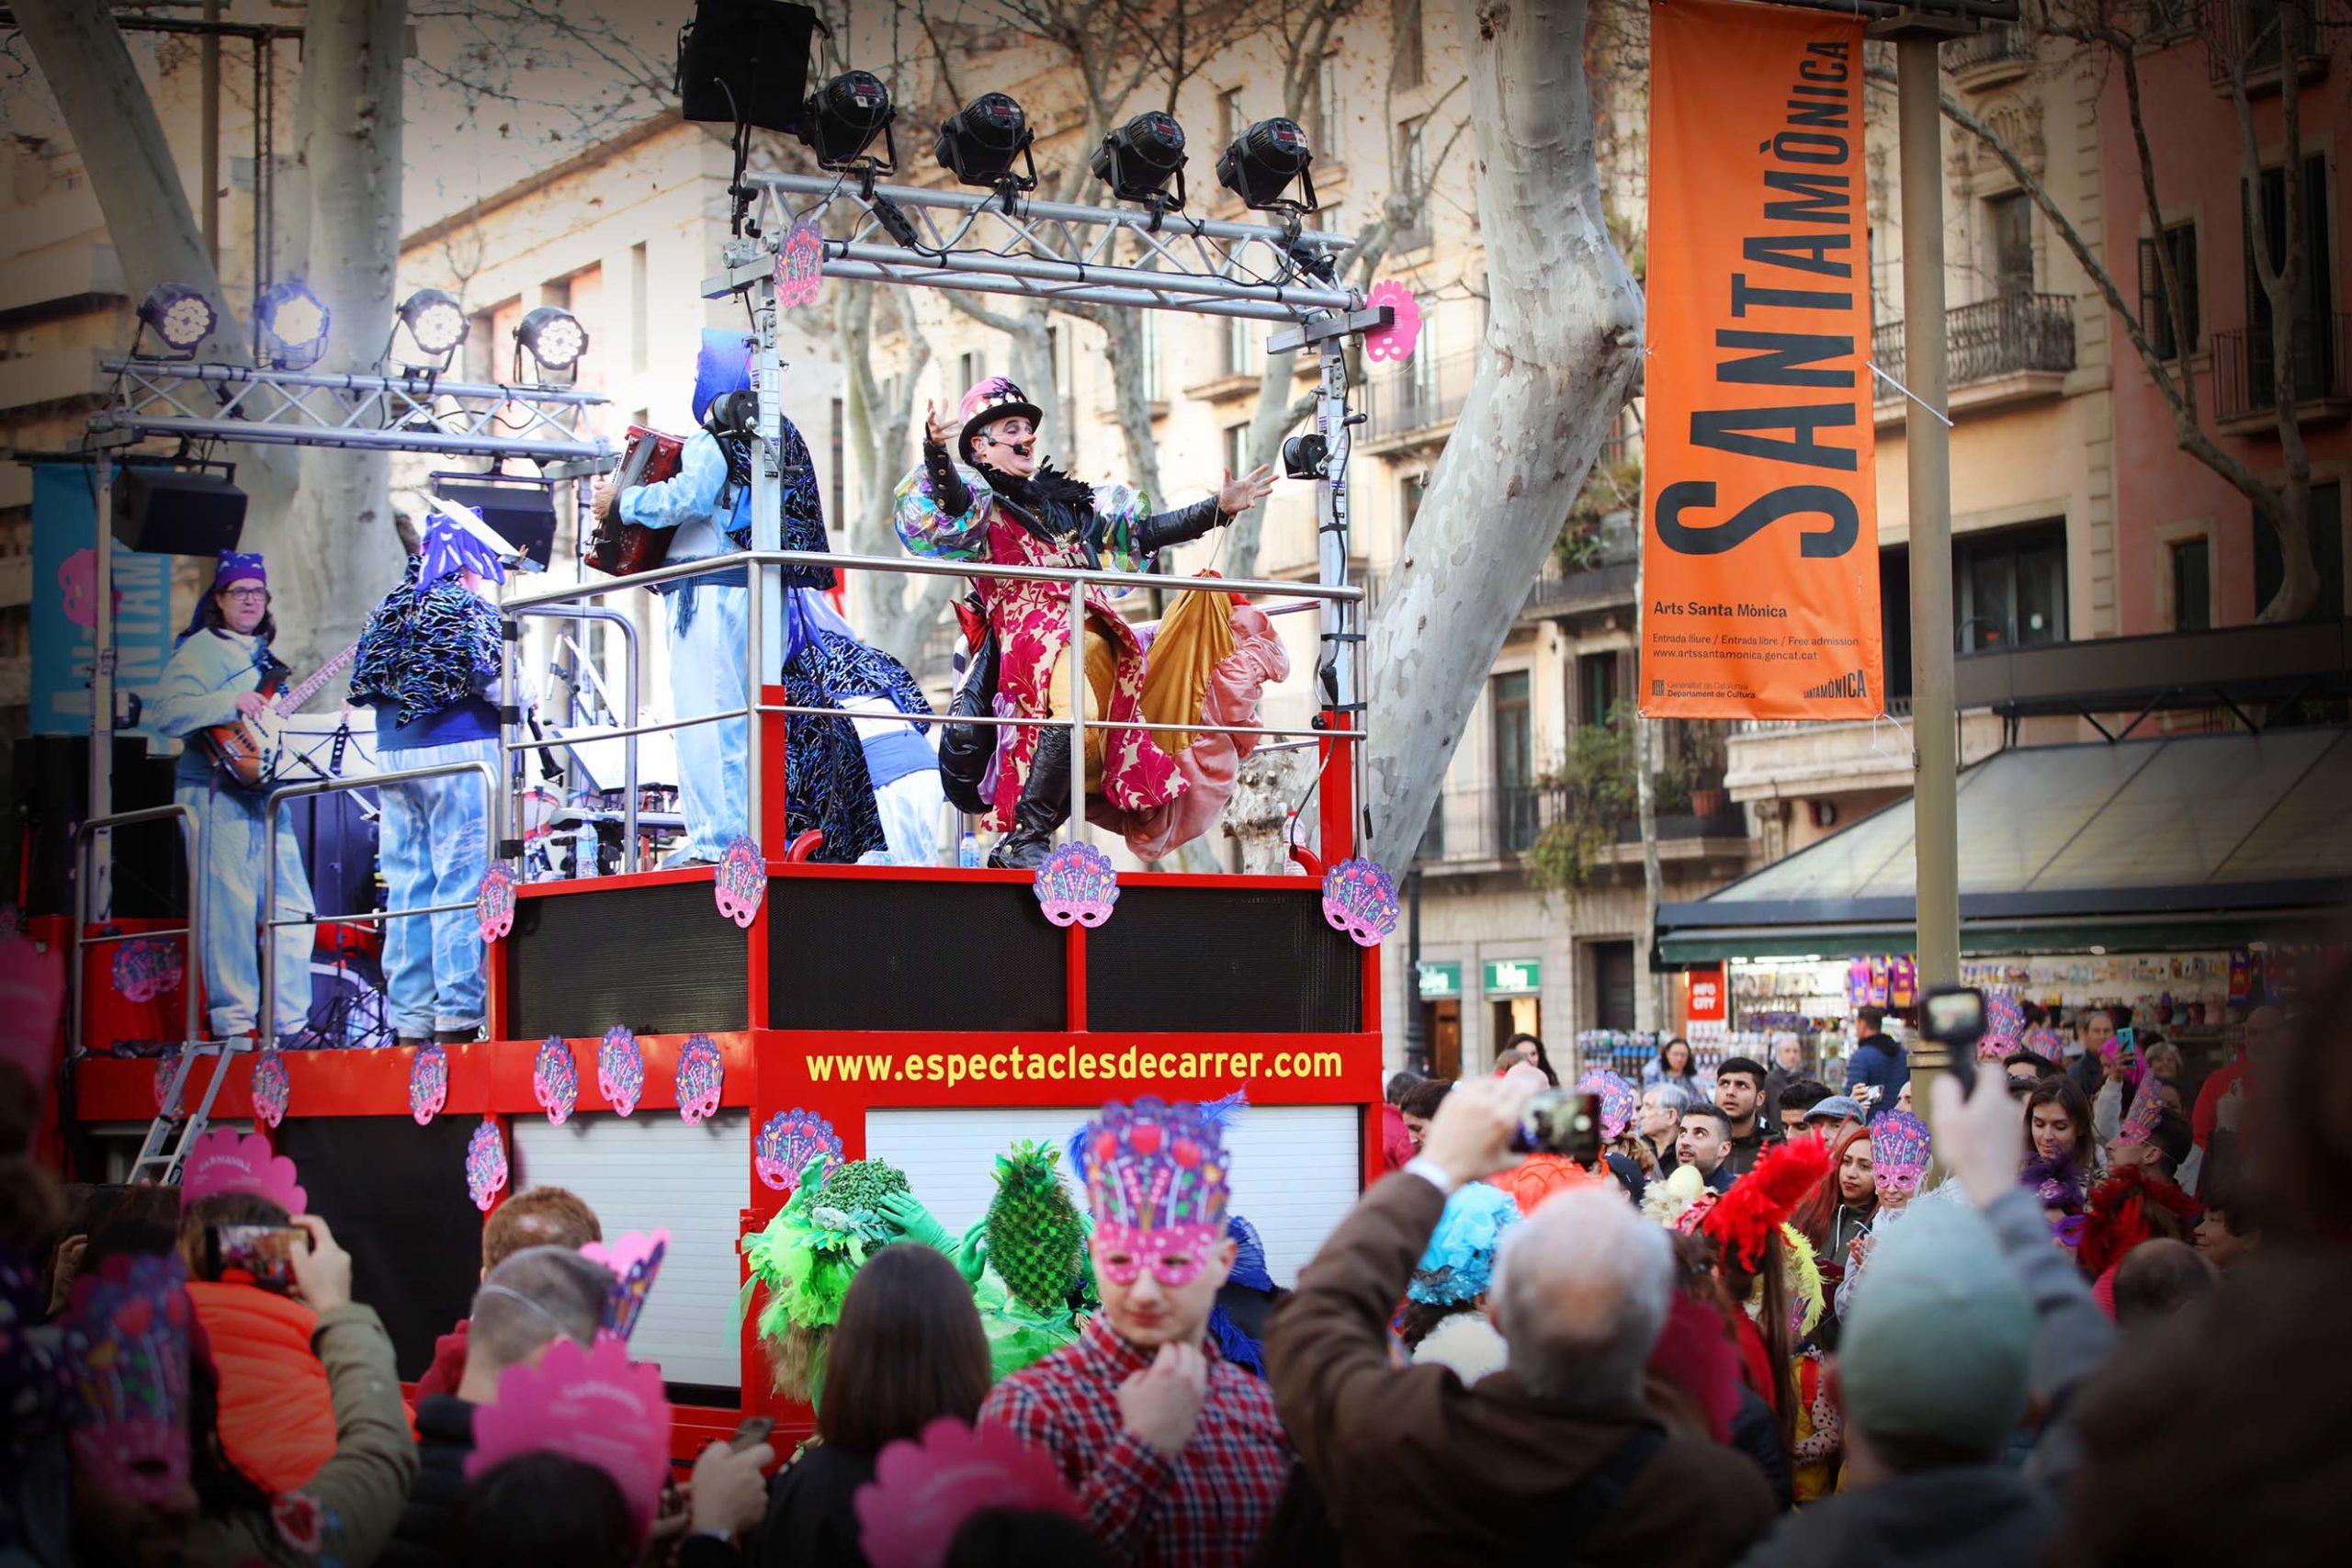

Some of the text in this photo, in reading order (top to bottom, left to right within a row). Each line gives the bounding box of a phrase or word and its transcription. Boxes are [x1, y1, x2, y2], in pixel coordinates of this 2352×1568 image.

[1655, 41, 1860, 558] SANTAMÒNICA
[1654, 601, 1788, 618] Arts Santa Mònica
[1653, 633, 1686, 644] Entrada
[1689, 633, 1711, 644] lliure
[1721, 635, 1757, 645] Entrada
[1758, 636, 1778, 645] libre
[1788, 636, 1808, 646] Free
[1811, 637, 1859, 647] admission
[1653, 649, 1817, 661] www.artssantamonica.gencat.cat
[1668, 689, 1756, 700] Departament de Cultura
[806, 1044, 1342, 1088] www.espectaclesdecarrer.com
